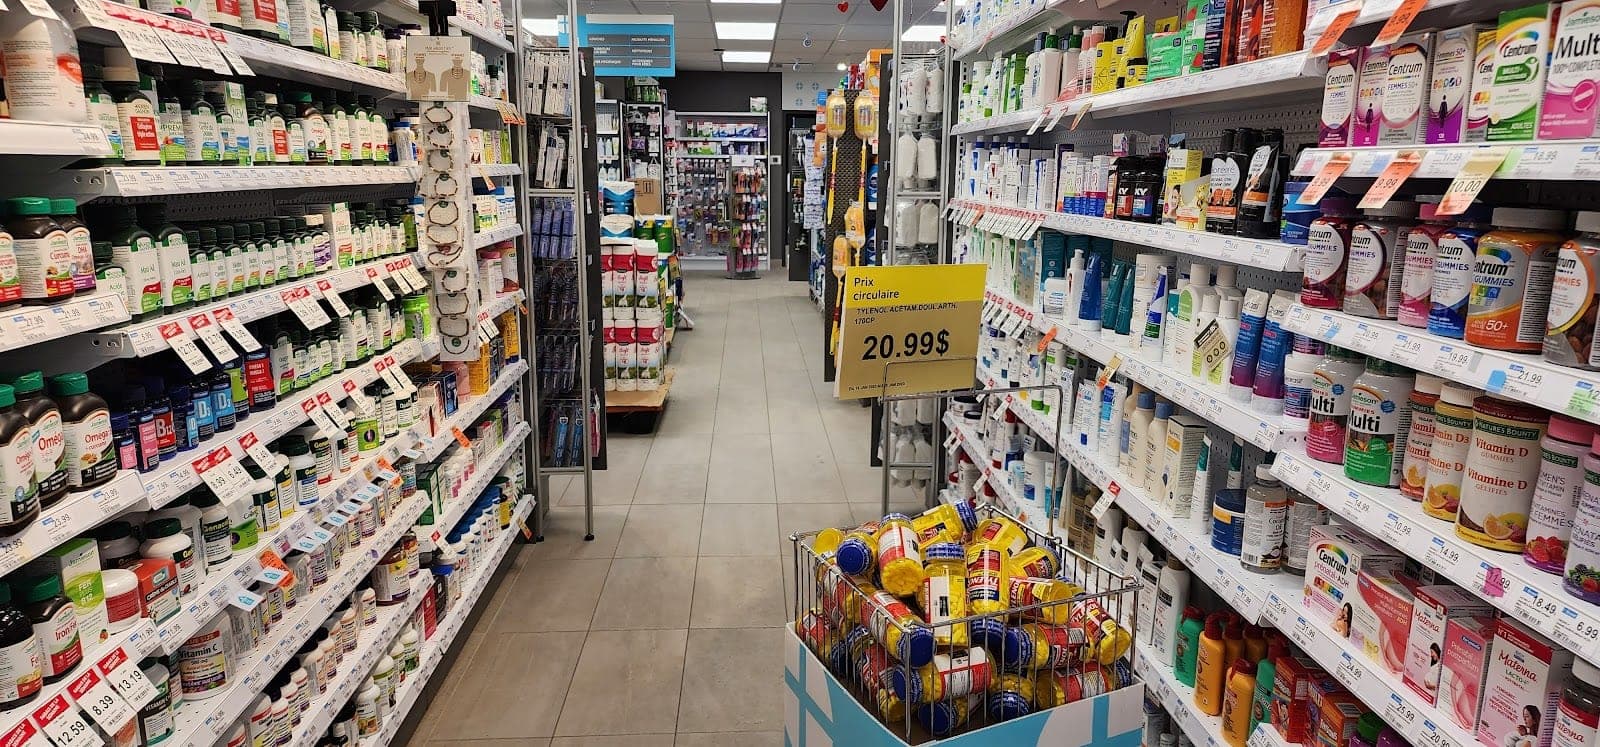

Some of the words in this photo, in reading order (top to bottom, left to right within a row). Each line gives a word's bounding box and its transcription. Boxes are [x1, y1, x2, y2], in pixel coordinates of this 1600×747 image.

[1504, 44, 1537, 58] Centrum
[1388, 63, 1422, 75] Centrum
[1328, 74, 1353, 85] Centrum
[854, 277, 874, 287] Prix
[854, 290, 900, 301] circulaire
[1486, 320, 1508, 331] 50+
[862, 329, 950, 360] 20.99$
[1448, 352, 1468, 364] 19.99
[1518, 370, 1542, 384] 21.99
[1456, 433, 1469, 444] D3
[1506, 428, 1536, 438] BOUNTY
[1476, 437, 1515, 456] Vitamin
[1519, 447, 1528, 457] D
[1454, 462, 1464, 472] D
[1468, 468, 1514, 488] Vitamine
[1518, 480, 1528, 490] D
[1355, 500, 1369, 511] 14.99
[54, 513, 70, 527] 23.99
[1394, 521, 1411, 535] 10.99
[5, 538, 23, 553] 23.99
[1441, 546, 1458, 562] 14.99
[1319, 550, 1347, 576] Centrum
[1489, 572, 1511, 590] 11.99
[1532, 596, 1556, 615] 18.49
[1415, 609, 1440, 633] Materna
[1576, 621, 1598, 638] 6.99
[1347, 663, 1362, 678] 24.99
[1499, 650, 1537, 682] Materna
[118, 671, 143, 692] 13.19
[92, 696, 114, 716] 8.39
[1396, 703, 1415, 722] 25.99
[57, 721, 85, 746] 12.59
[1556, 720, 1585, 743] aterna
